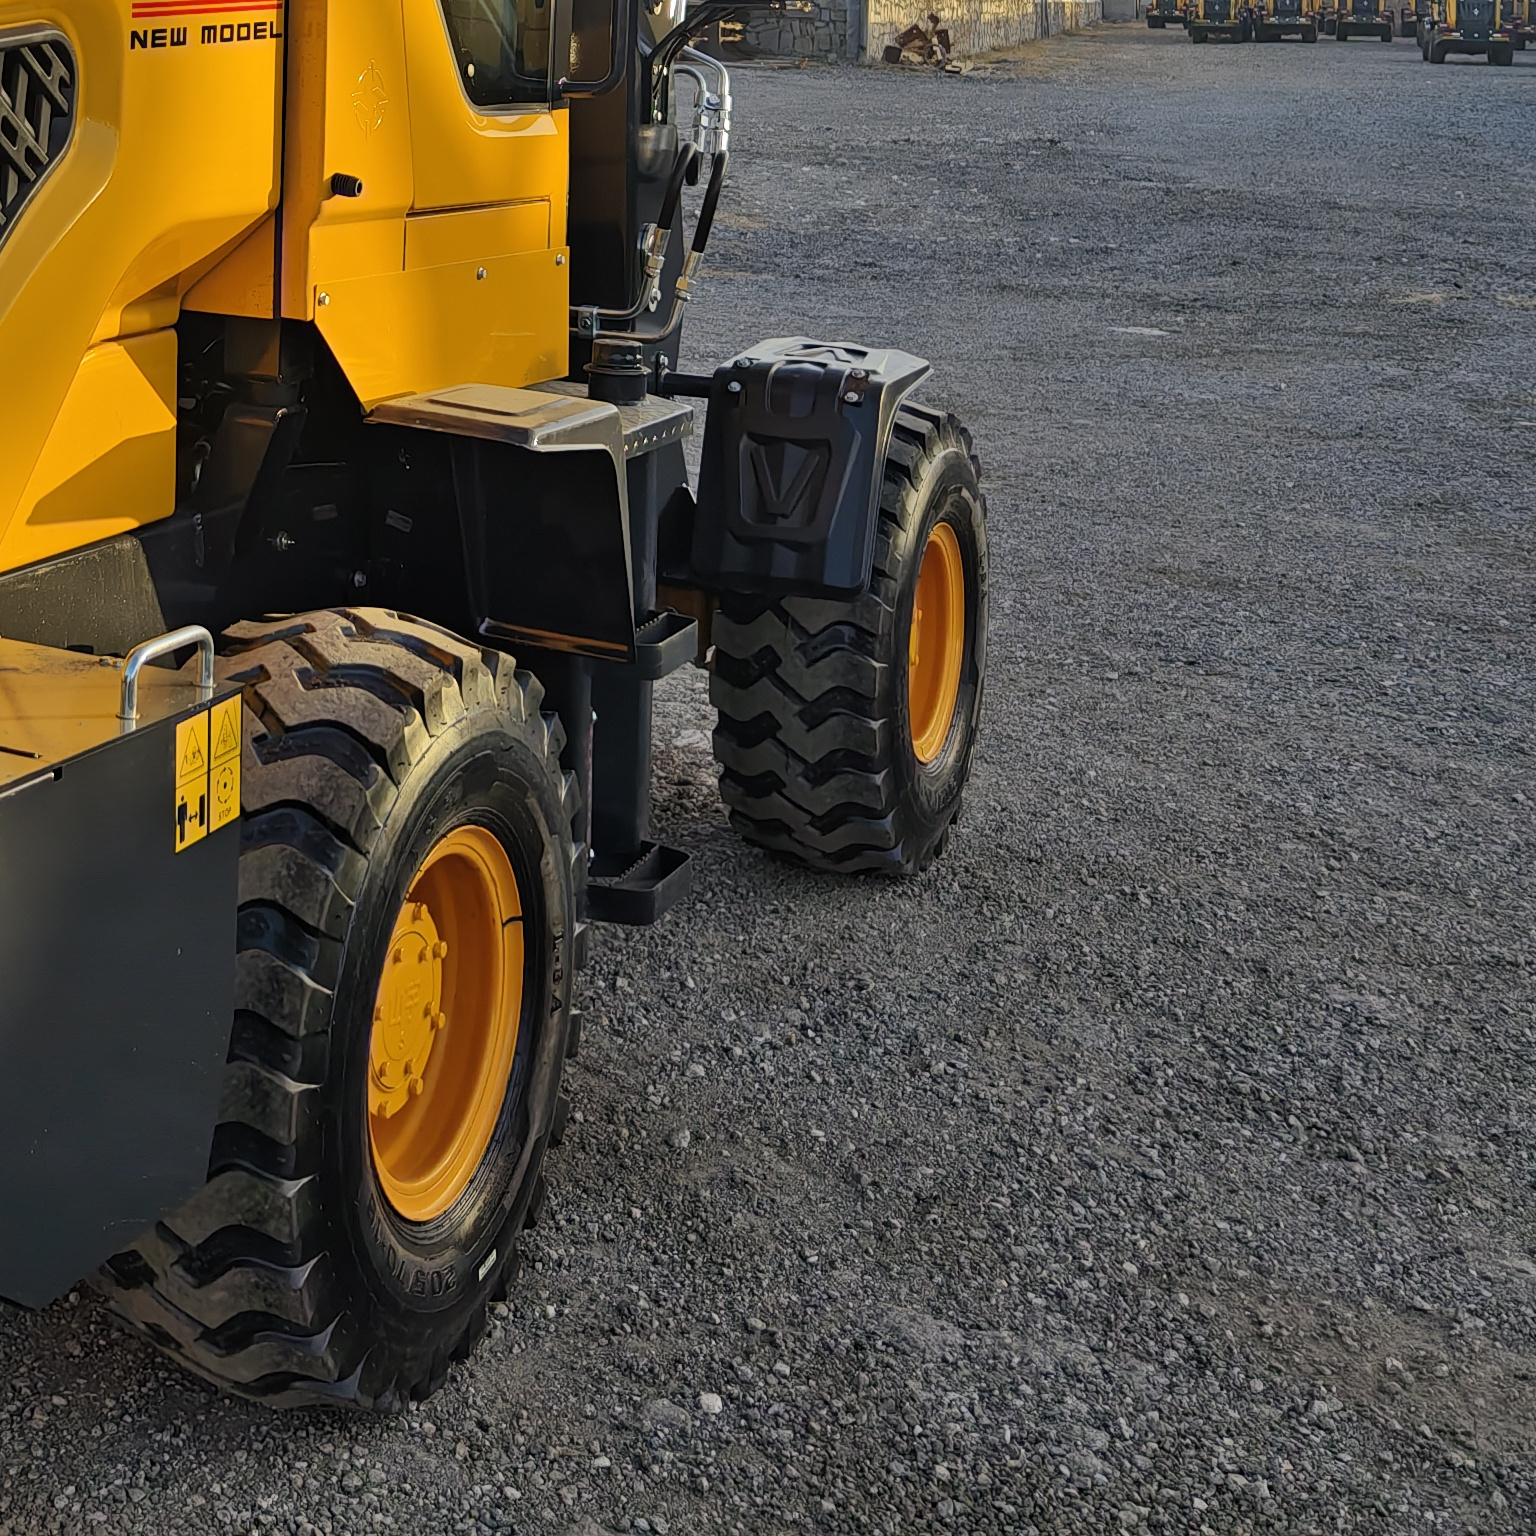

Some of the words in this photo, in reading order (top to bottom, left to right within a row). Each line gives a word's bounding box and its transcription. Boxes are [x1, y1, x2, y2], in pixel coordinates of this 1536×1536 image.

[130, 26, 188, 50] NEW
[201, 21, 283, 45] MODEL
[218, 805, 232, 822] STOP
